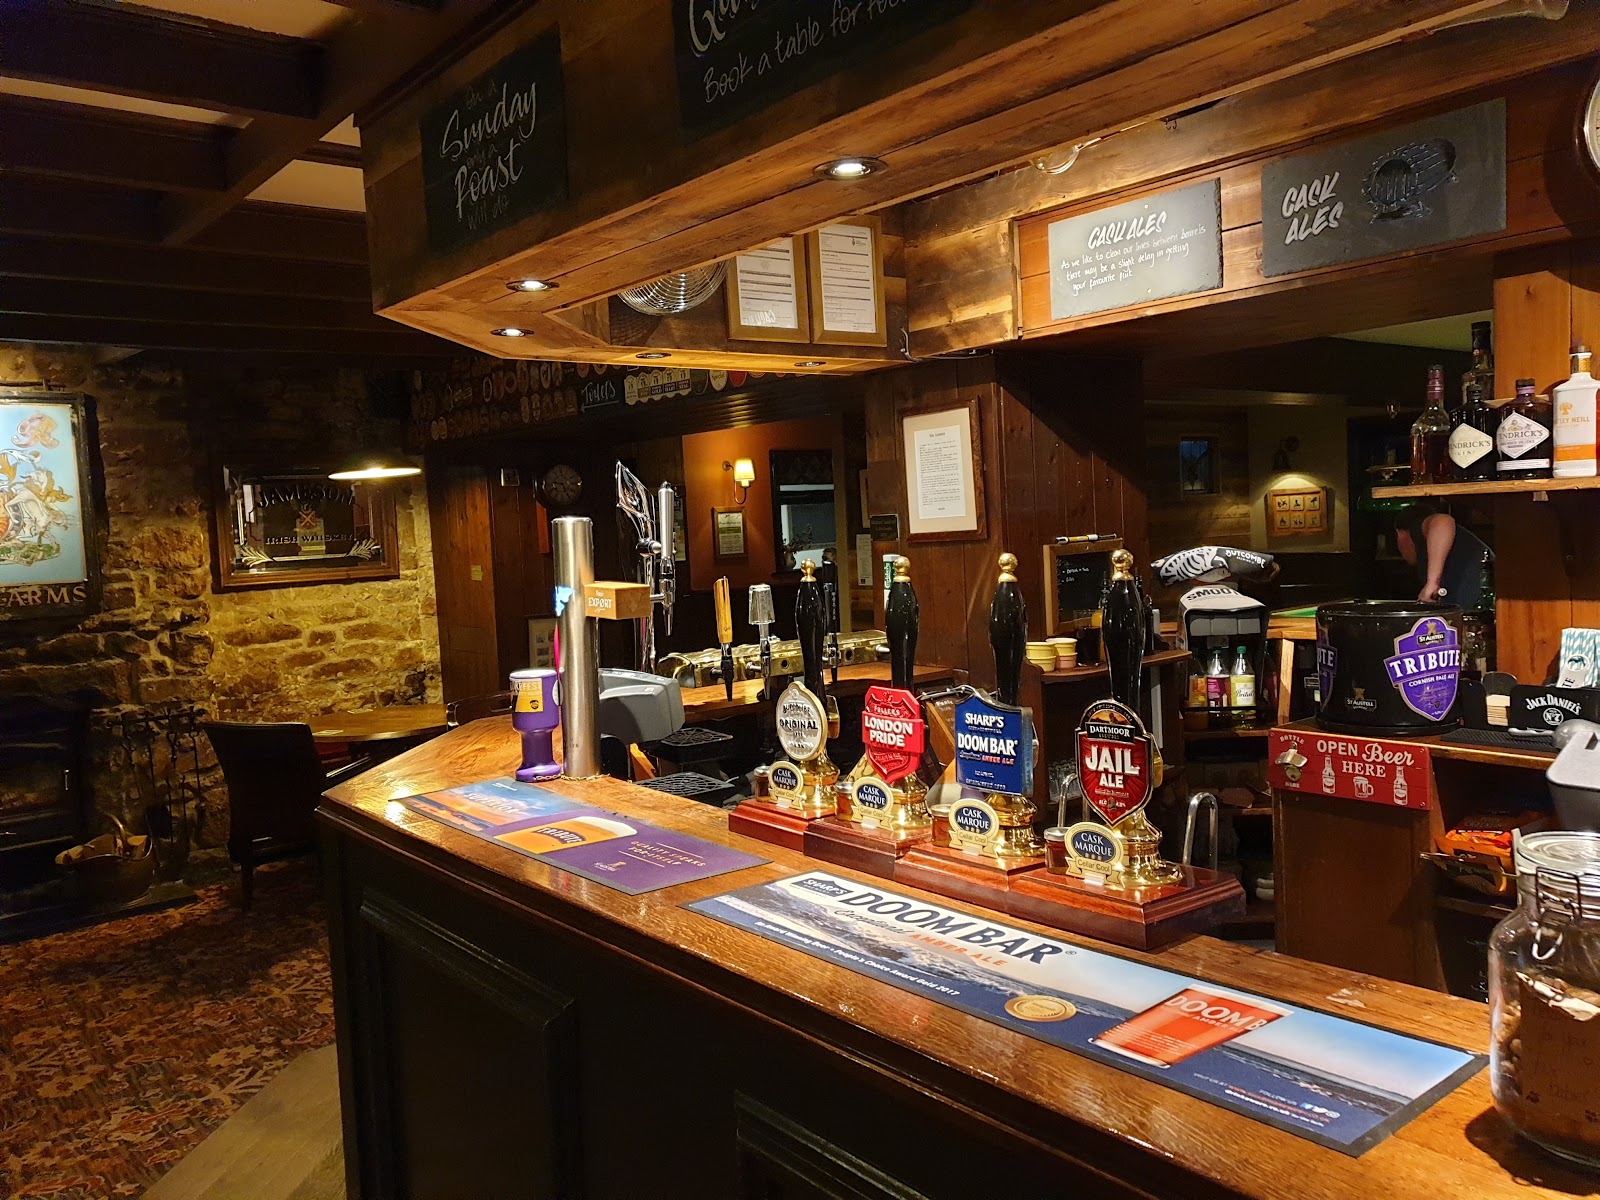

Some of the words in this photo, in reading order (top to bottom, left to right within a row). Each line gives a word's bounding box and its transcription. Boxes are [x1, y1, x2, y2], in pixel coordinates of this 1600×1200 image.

[703, 53, 753, 103] Book
[758, 52, 772, 75] a
[774, 16, 824, 64] table
[831, 0, 862, 37] for
[441, 81, 537, 158] Sunday
[455, 139, 524, 222] Roast
[1282, 172, 1340, 218] CASK
[1126, 211, 1167, 241] ALES
[1285, 202, 1344, 245] ALES
[1084, 266, 1097, 279] may
[1100, 262, 1108, 272] be
[1118, 256, 1135, 272] slight
[1156, 249, 1164, 258] in
[1165, 243, 1190, 261] getting
[1095, 252, 1104, 261] to
[1123, 246, 1133, 254] our
[1072, 281, 1087, 297] your
[1225, 549, 1267, 569] BUTCOMBE
[1389, 649, 1460, 679] TRIBUTE
[1525, 696, 1547, 711] JACK
[1546, 694, 1582, 716] DANIEL'S
[864, 715, 913, 736] LONDON
[965, 712, 1005, 728] SHARP'S
[869, 730, 906, 748] PRIDE
[1089, 725, 1131, 738] DARTMOOR
[957, 733, 989, 753] DOOM
[1085, 744, 1140, 775] JAIL
[1316, 740, 1359, 757] OPEN
[1361, 743, 1415, 766] Beer
[777, 768, 792, 778] CASK
[1341, 760, 1387, 778] HERE
[773, 775, 796, 787] MARQUE
[863, 785, 880, 796] CASK
[1099, 773, 1124, 789] ALE
[858, 792, 886, 806] MARQUE
[956, 815, 990, 830] MARQUE
[962, 807, 983, 819] CASK
[537, 827, 583, 844] TRIBUTE
[1081, 832, 1104, 846] CASK
[628, 846, 648, 858] FOR
[649, 851, 682, 865] ITSELF
[630, 840, 668, 855] QUALITY
[670, 853, 706, 867] SPEAKS
[1074, 840, 1113, 857] MARQUE
[1077, 859, 1095, 870] Cellar
[1096, 862, 1110, 873] Cool
[803, 879, 848, 895] SHARP'S
[838, 892, 977, 936] DOOM
[908, 933, 968, 954] AMBER
[968, 953, 1009, 967] ALE
[764, 924, 788, 934] Award
[785, 931, 813, 944] Winning
[810, 941, 831, 950] Beer
[864, 960, 891, 972] Choice
[890, 970, 918, 981] Award
[916, 978, 939, 988] Gold
[936, 985, 960, 996] 2017
[1163, 995, 1256, 1027] DOOM
